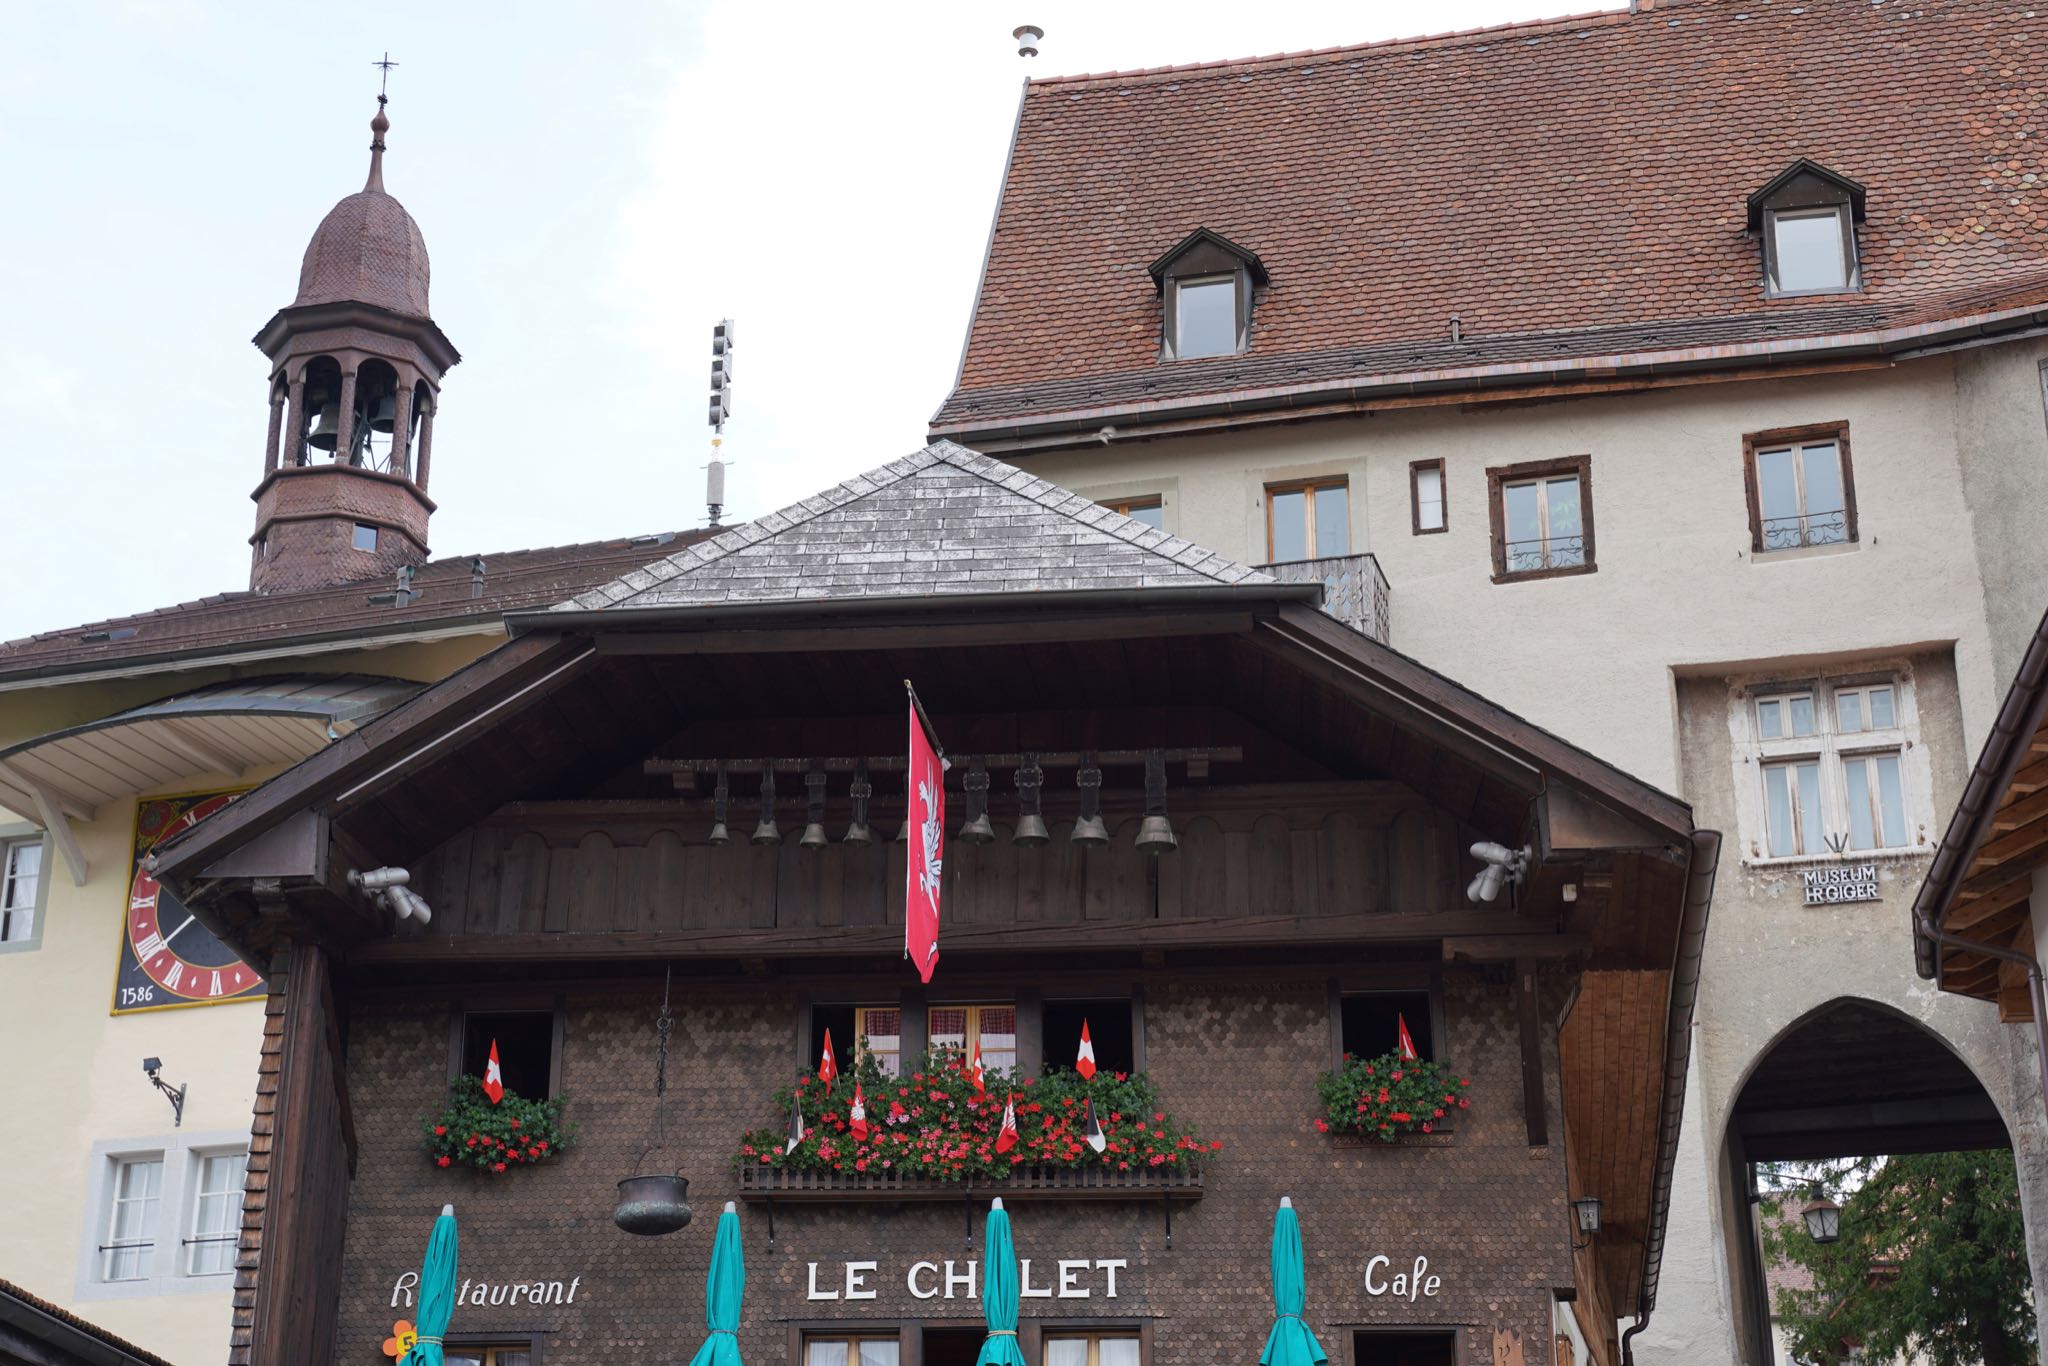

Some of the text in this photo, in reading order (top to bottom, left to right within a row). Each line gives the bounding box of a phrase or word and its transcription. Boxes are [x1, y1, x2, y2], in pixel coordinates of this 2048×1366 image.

[1804, 866, 1876, 886] MUSEUM
[1806, 883, 1877, 902] HR GIGER
[121, 985, 154, 1005] 1586
[391, 1271, 581, 1308] Rtaurant
[807, 1259, 1127, 1300] LE CHLET
[1365, 1255, 1441, 1302] Cafe
